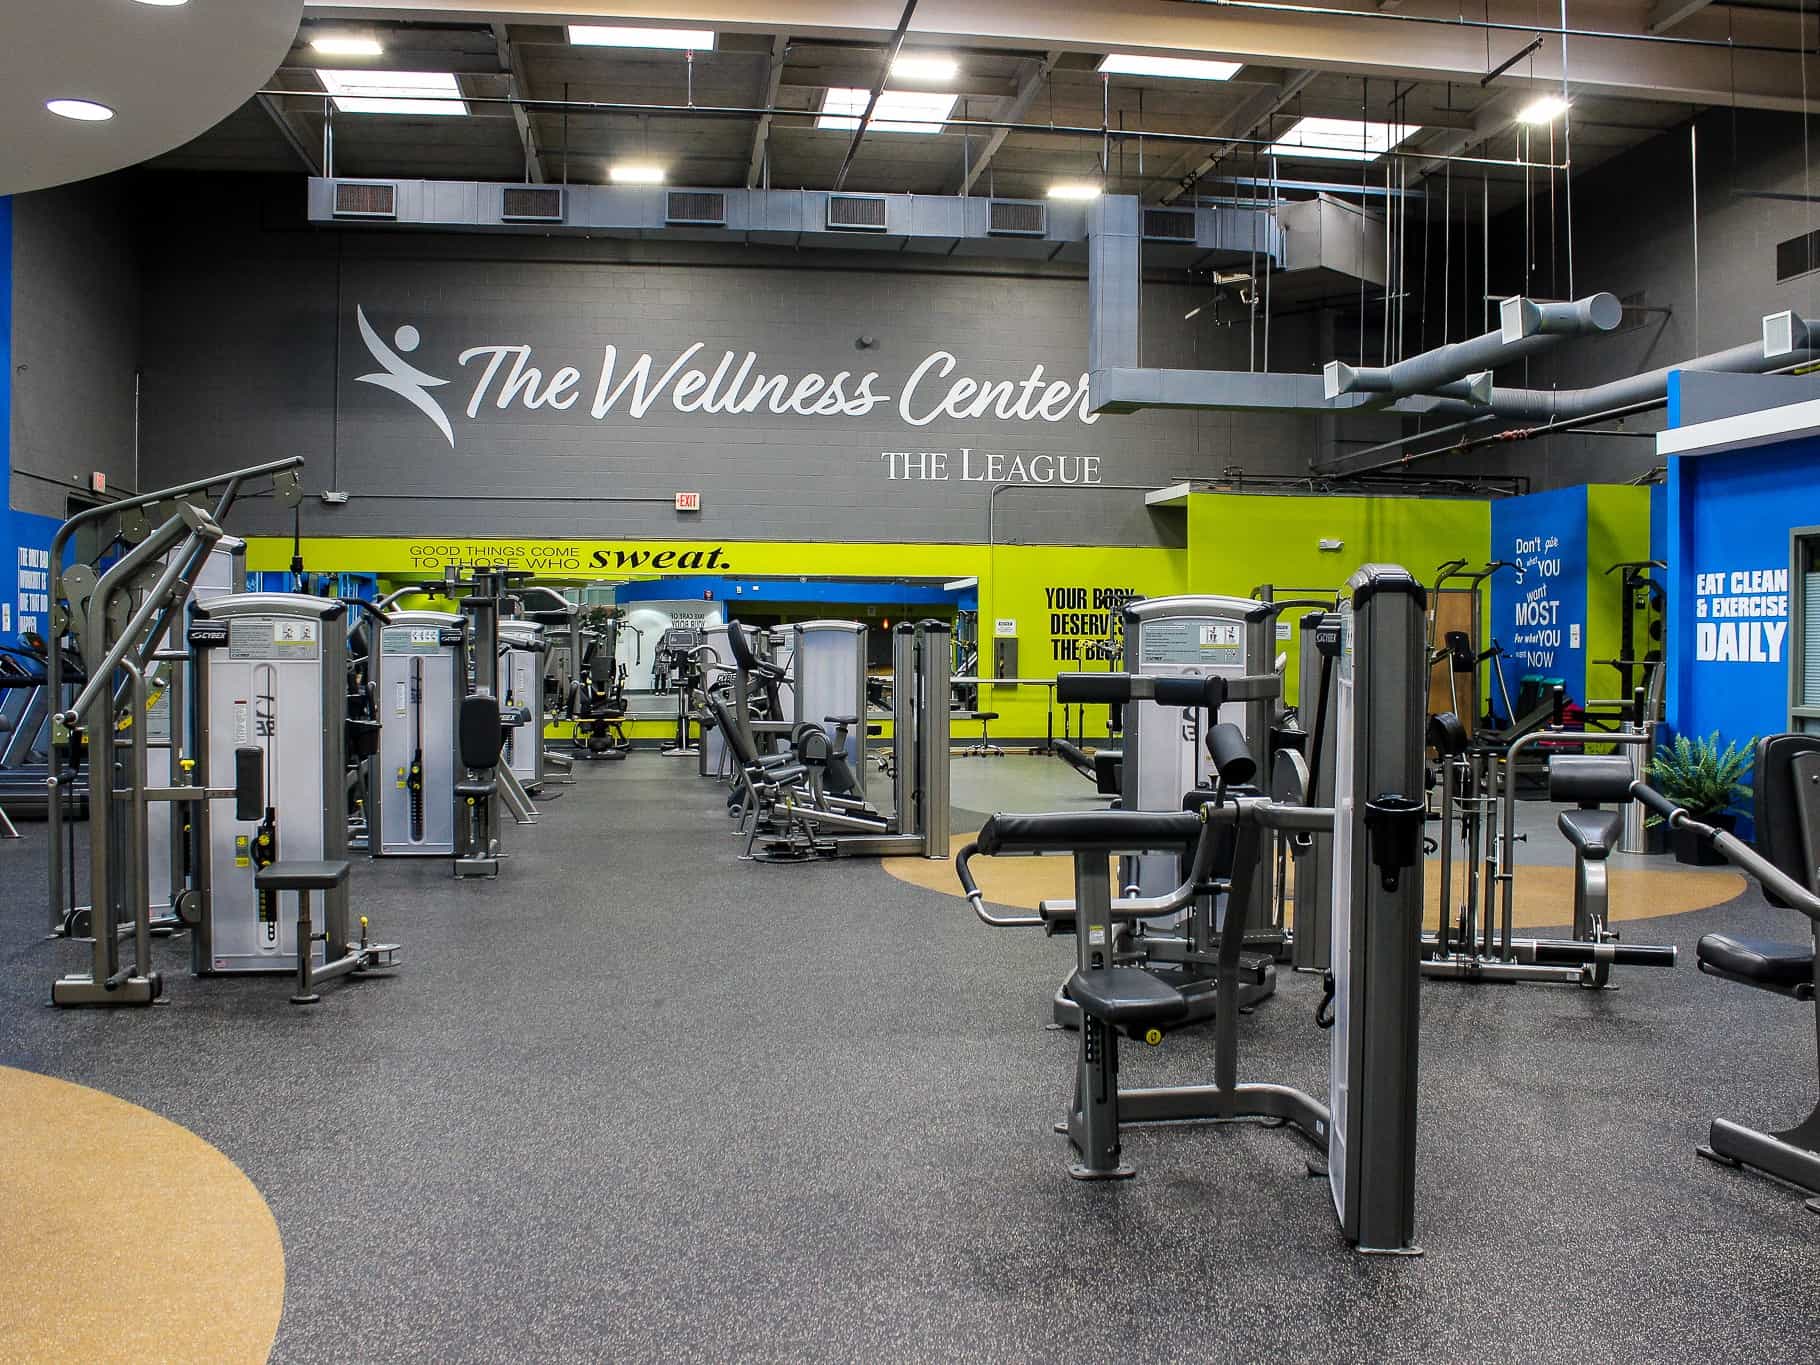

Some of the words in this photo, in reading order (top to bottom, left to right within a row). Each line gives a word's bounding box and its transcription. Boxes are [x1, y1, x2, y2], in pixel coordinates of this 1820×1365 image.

[458, 344, 581, 418] The
[590, 342, 892, 419] Wellness
[899, 350, 1101, 426] Center
[881, 452, 949, 481] THE
[960, 448, 1102, 484] LEAGUE
[680, 494, 697, 507] EXIT
[410, 545, 461, 556] GOOD
[465, 546, 526, 557] THINGS
[530, 547, 581, 558] COME
[1515, 536, 1541, 555] Don't
[410, 557, 439, 569] TO
[447, 557, 519, 569] THOSE
[526, 558, 581, 570] WHO
[588, 546, 731, 569] sweat.
[1538, 559, 1561, 577] YOU
[1696, 573, 1726, 595] EAT
[1731, 568, 1788, 594] CLEAN
[1045, 587, 1088, 610] YOUR
[1526, 583, 1547, 603] want
[1515, 600, 1560, 626] MOST
[1696, 597, 1708, 618] &
[1712, 596, 1788, 618] EXERCISE
[1051, 638, 1080, 660] THE
[1537, 629, 1561, 647] YOU
[1696, 621, 1788, 662] DAILY
[1527, 651, 1554, 668] NOW
